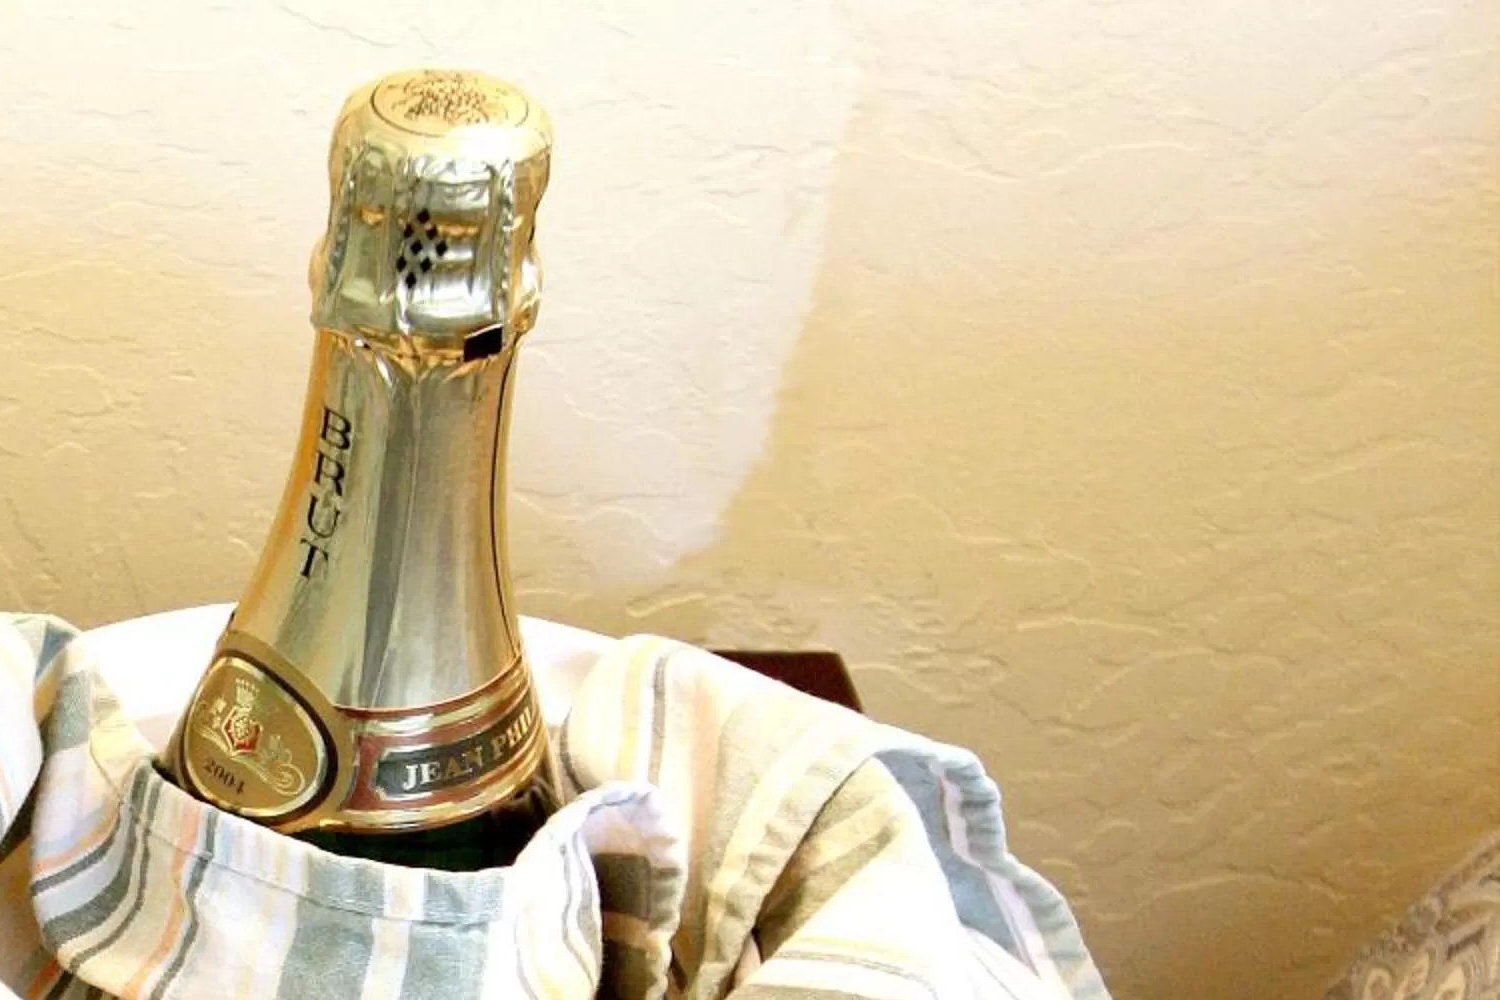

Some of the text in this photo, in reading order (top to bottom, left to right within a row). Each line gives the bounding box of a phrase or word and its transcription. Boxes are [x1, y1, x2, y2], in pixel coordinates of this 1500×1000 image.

[299, 405, 352, 578] BRUT
[203, 757, 246, 796] 2004
[402, 743, 485, 791] JEAN
